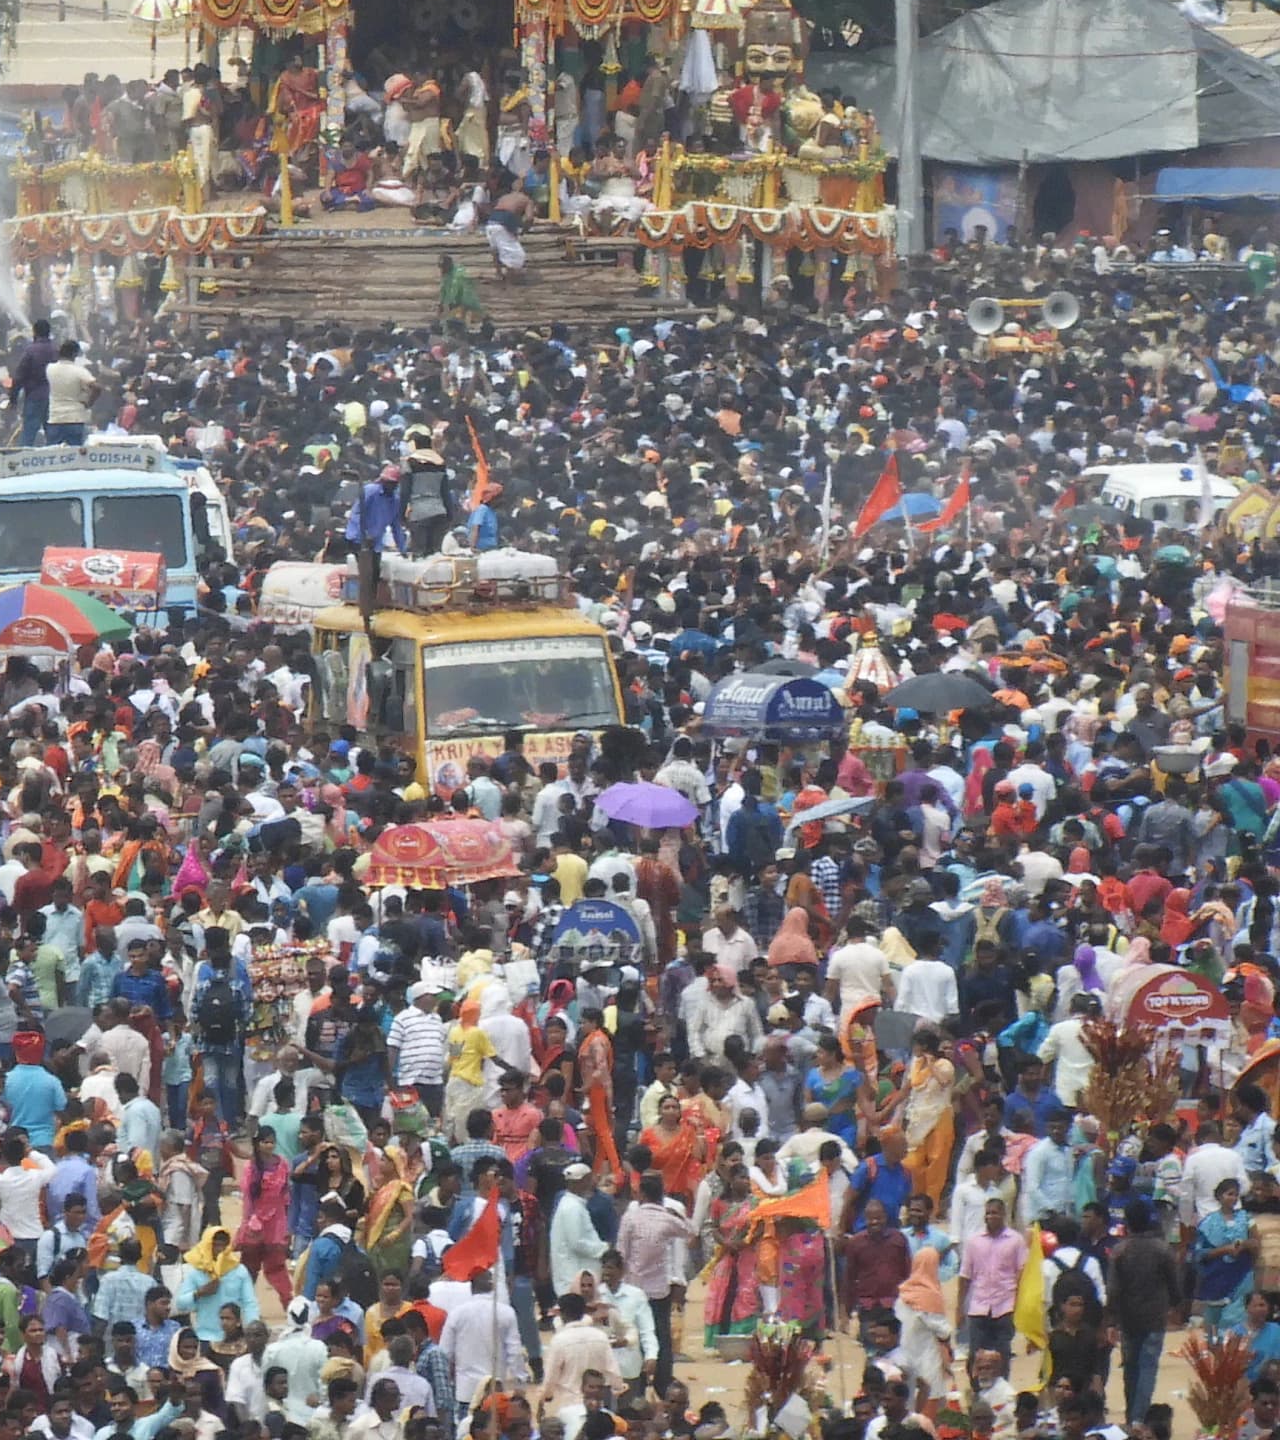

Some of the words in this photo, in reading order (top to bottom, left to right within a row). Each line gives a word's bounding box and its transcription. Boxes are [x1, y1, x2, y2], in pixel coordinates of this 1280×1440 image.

[61, 453, 75, 464] OF
[89, 452, 141, 464] ODISHA
[778, 689, 833, 712] Amul
[433, 739, 485, 761] KRIYA
